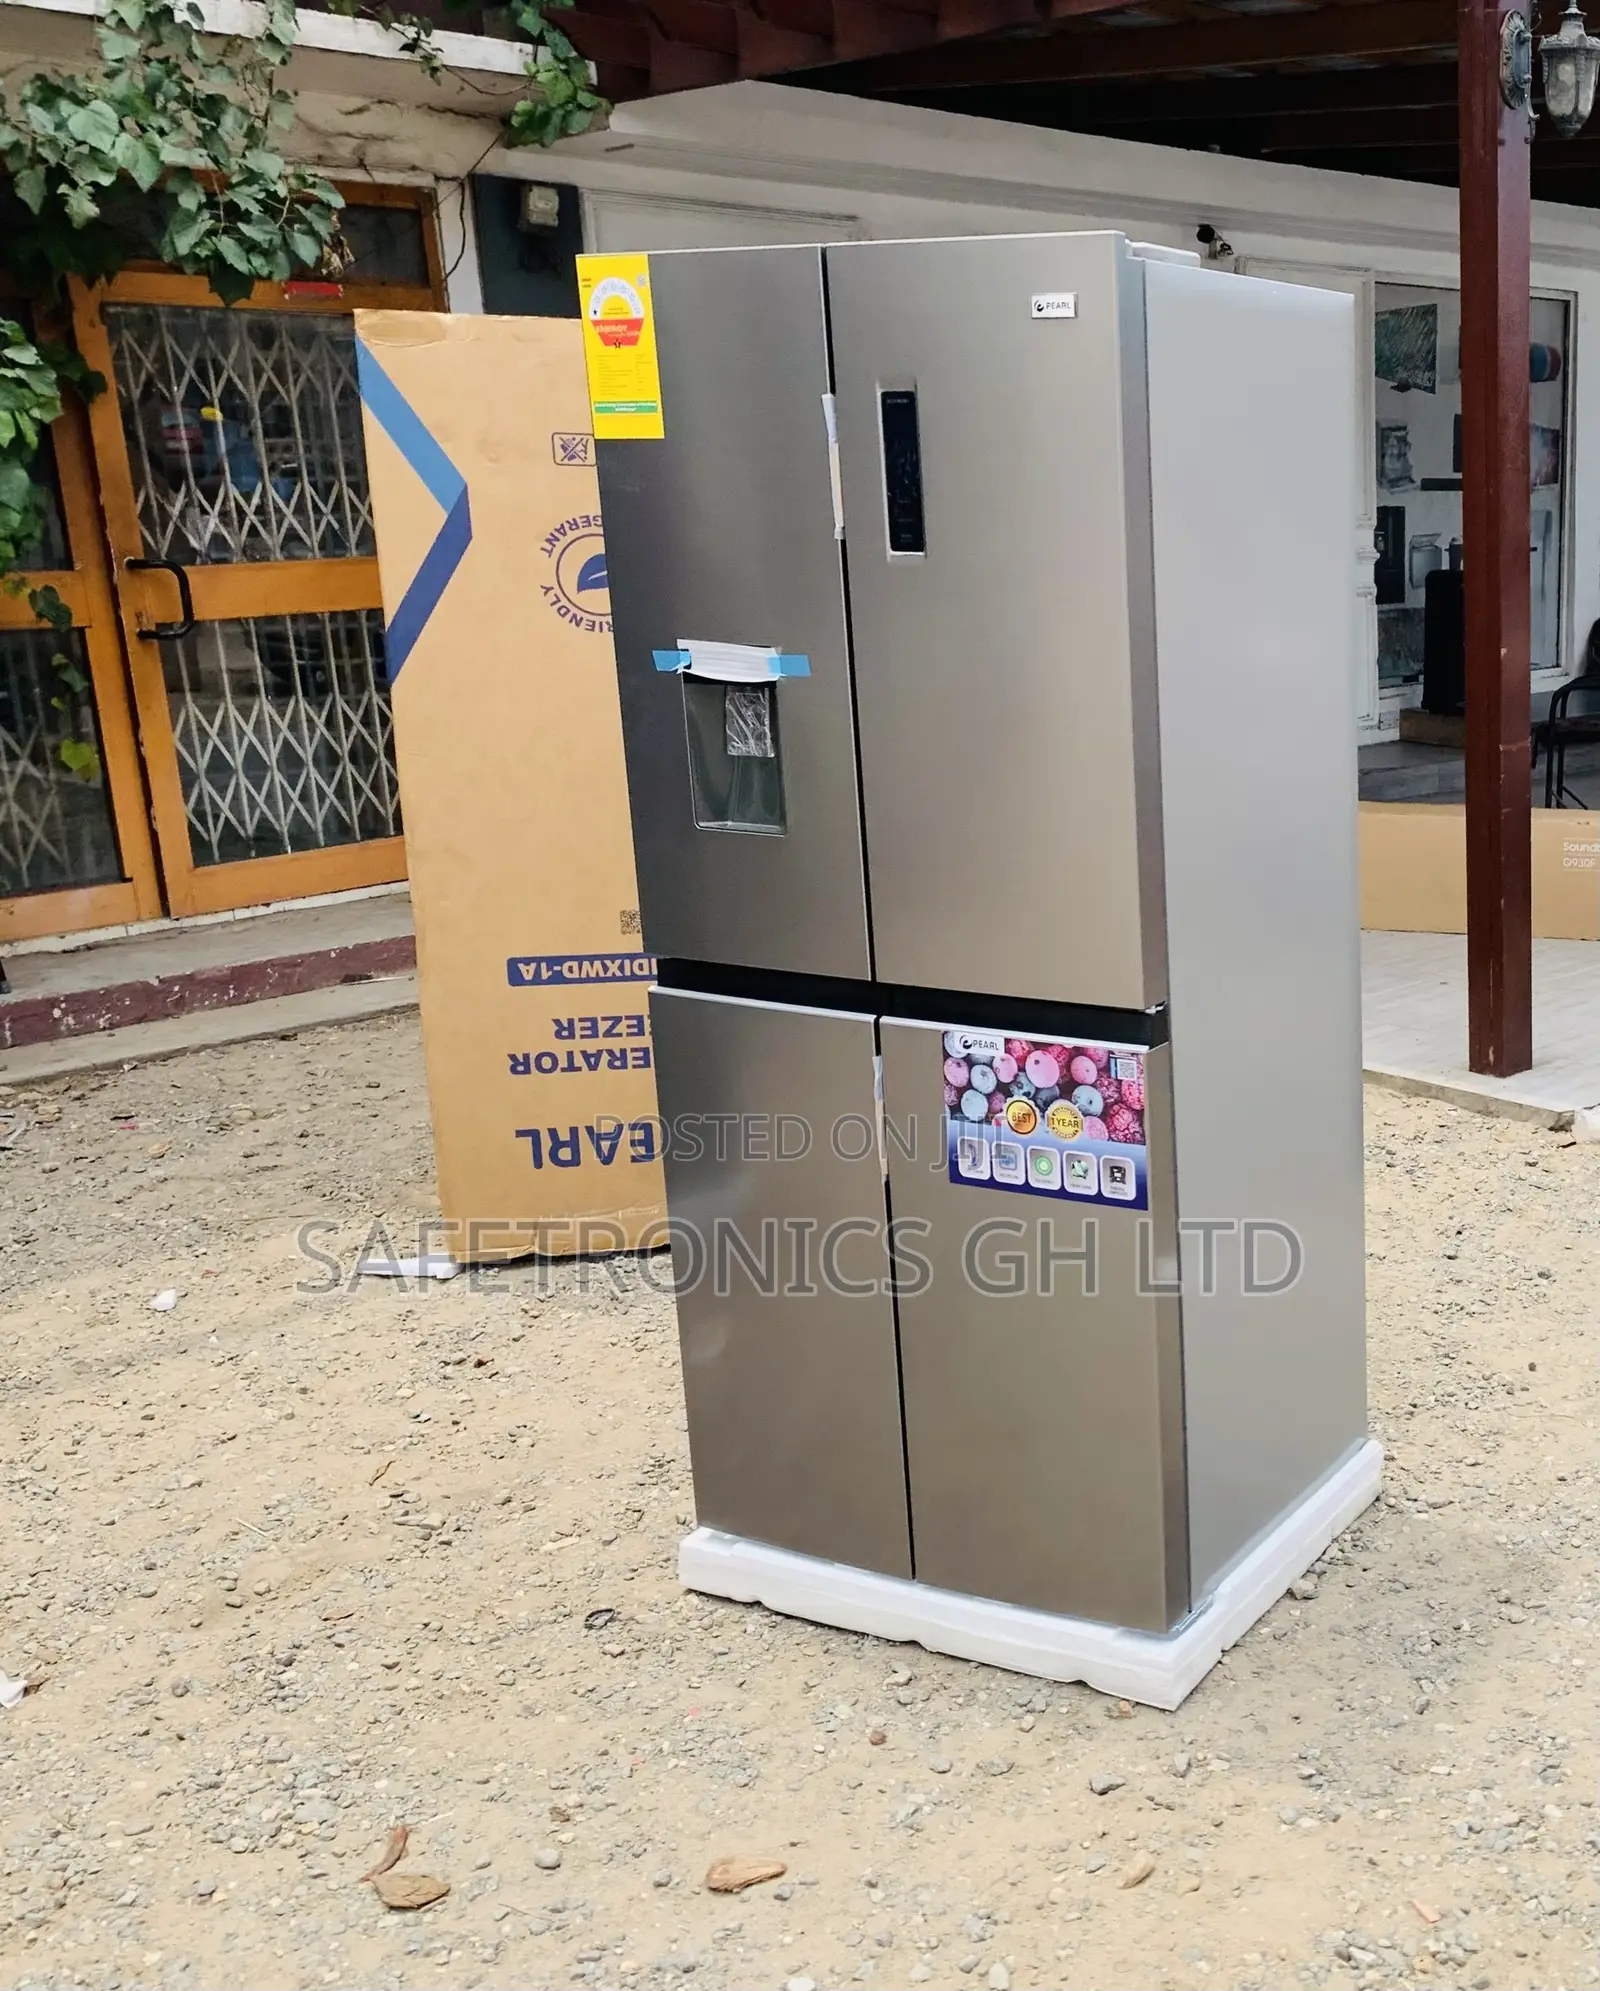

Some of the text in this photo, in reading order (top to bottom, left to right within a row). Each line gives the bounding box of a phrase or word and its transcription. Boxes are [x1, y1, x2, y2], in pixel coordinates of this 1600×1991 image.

[1046, 301, 1072, 310] PEARL
[551, 1014, 652, 1040] EZER
[973, 1039, 999, 1051] PEARL
[1011, 1111, 1032, 1124] BEST
[1056, 1118, 1079, 1129] YEAR
